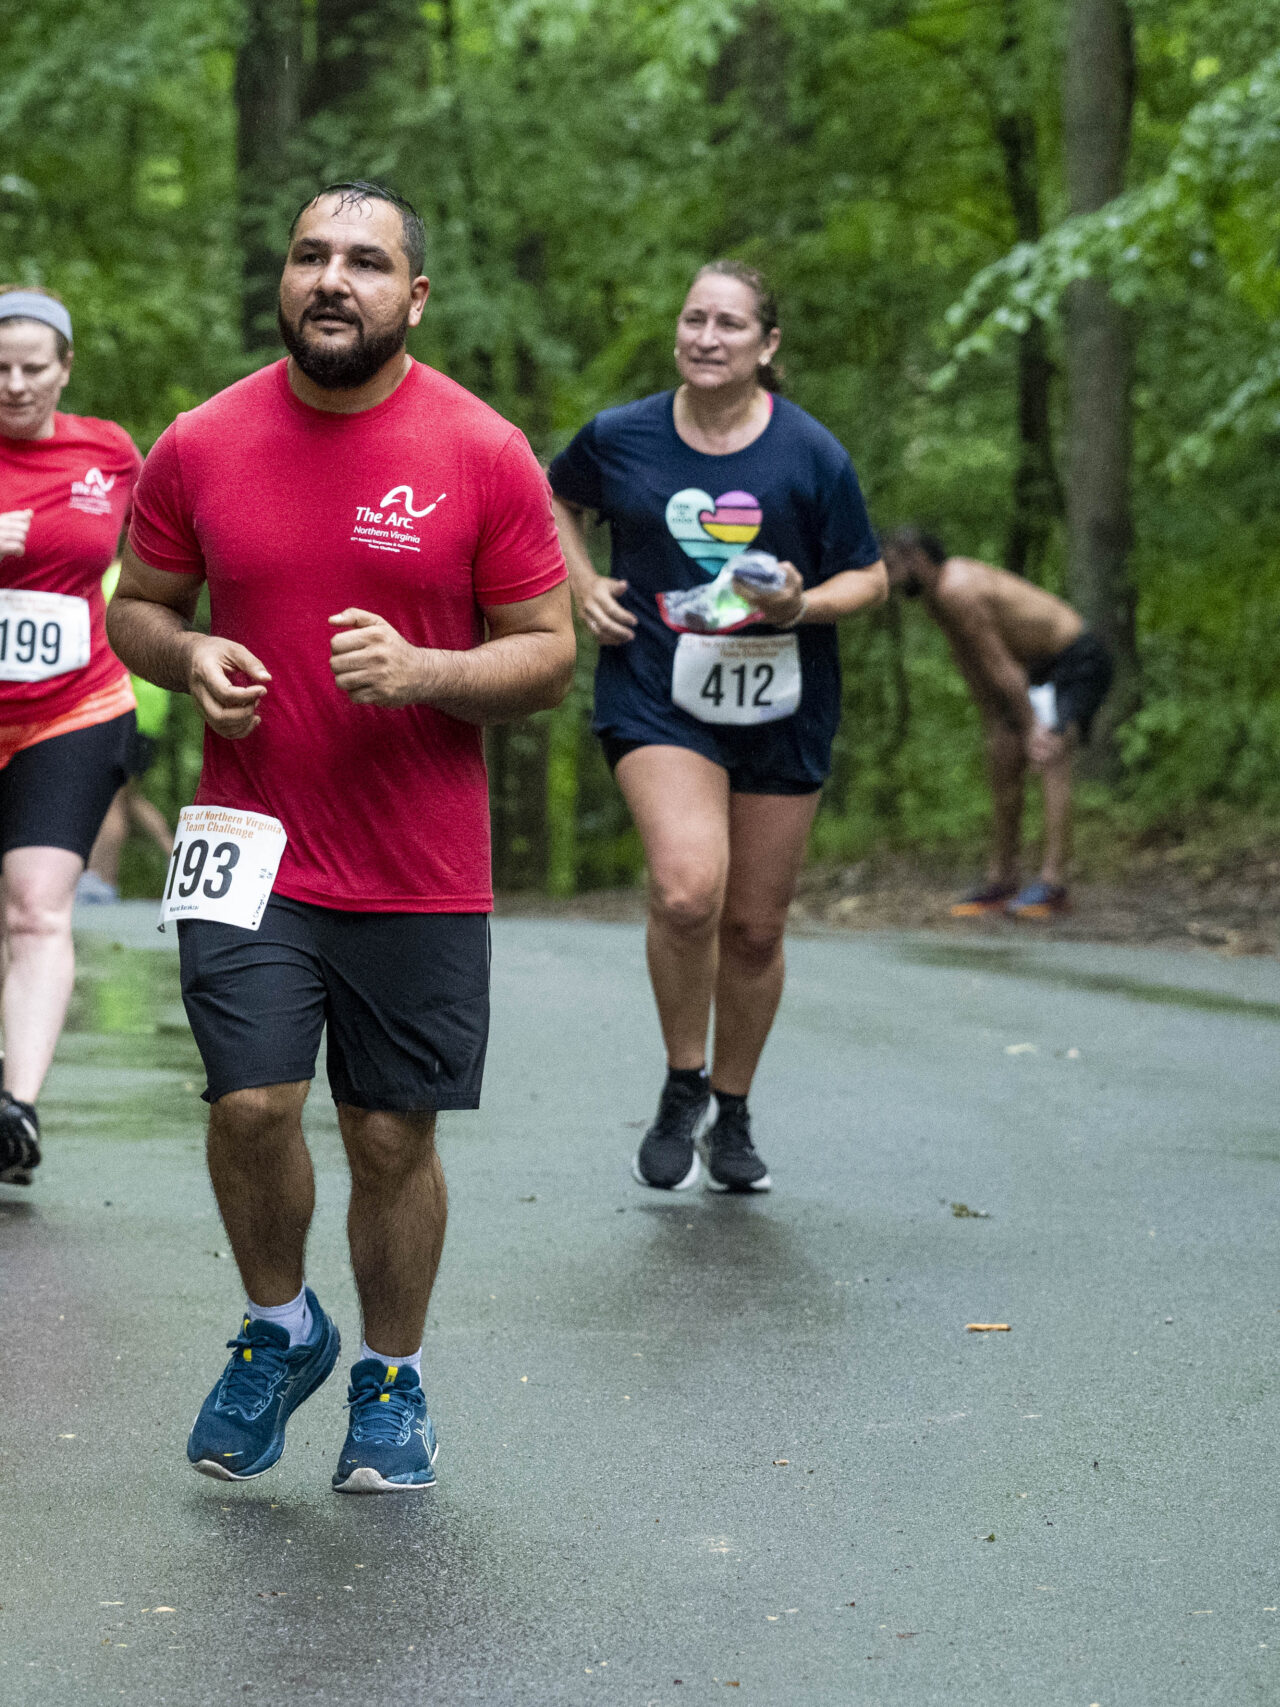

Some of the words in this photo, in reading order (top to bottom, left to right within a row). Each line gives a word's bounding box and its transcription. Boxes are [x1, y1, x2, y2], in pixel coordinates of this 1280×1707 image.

[356, 506, 383, 523] The
[385, 511, 414, 529] Arc
[353, 525, 389, 537] Northern
[390, 530, 421, 544] Virginia
[701, 662, 774, 707] 412
[183, 811, 194, 821] Arc
[195, 811, 204, 820] of
[205, 810, 243, 824] Northern
[245, 816, 282, 835] Virginia
[185, 822, 205, 832] Team
[207, 821, 255, 839] Challenge
[166, 838, 241, 900] 193
